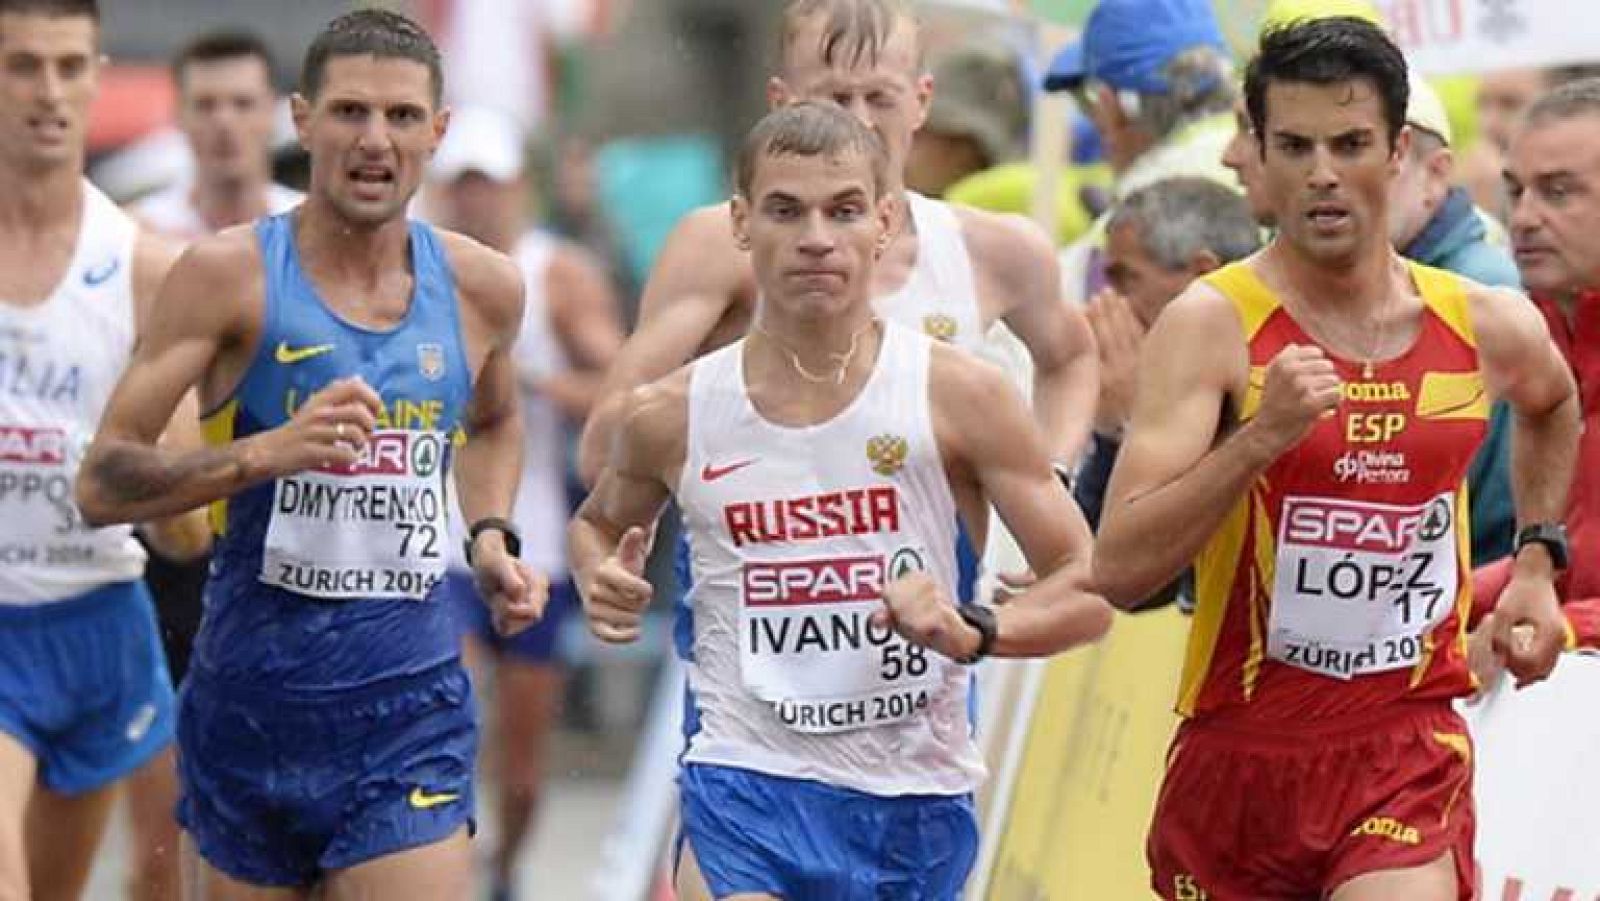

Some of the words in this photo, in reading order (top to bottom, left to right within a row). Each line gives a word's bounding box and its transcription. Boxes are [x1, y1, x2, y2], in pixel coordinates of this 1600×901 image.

[1346, 412, 1405, 443] ESP
[279, 478, 437, 523] DMYTRENKO
[724, 487, 899, 547] RUSSIA
[396, 523, 440, 558] 72
[747, 560, 883, 601] SPAR
[1296, 552, 1434, 601] LÓPZ
[1394, 588, 1443, 624] 17
[751, 612, 894, 655] IVANO
[1384, 634, 1425, 664] 201
[880, 640, 927, 681] 58
[1174, 873, 1207, 901] ES
